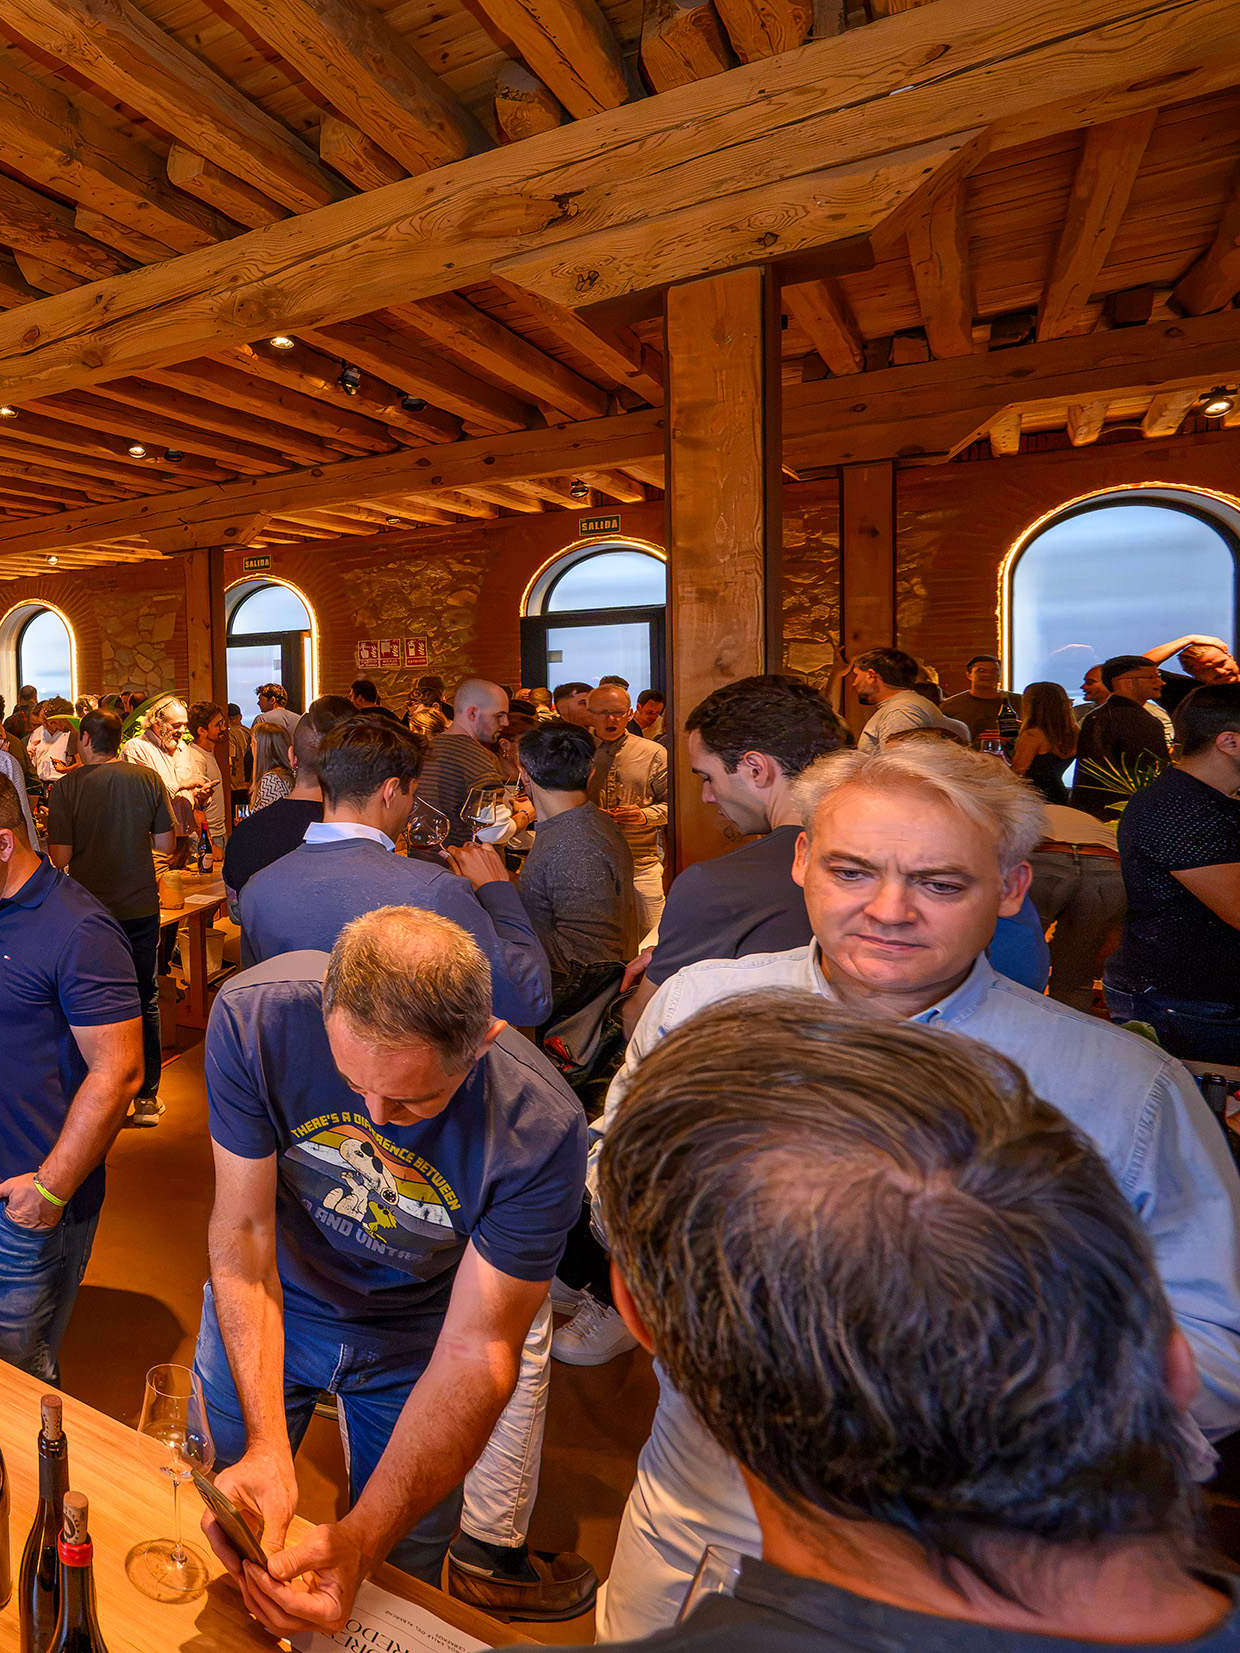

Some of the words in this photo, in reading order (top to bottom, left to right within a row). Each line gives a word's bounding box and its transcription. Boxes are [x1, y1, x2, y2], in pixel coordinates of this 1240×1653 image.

[581, 519, 618, 531] SALIDA
[245, 558, 270, 568] SALIDA
[290, 1112, 340, 1139] THERE'S
[341, 1111, 351, 1123] A
[413, 1157, 461, 1211] BETWEEN
[315, 1207, 354, 1237] AND
